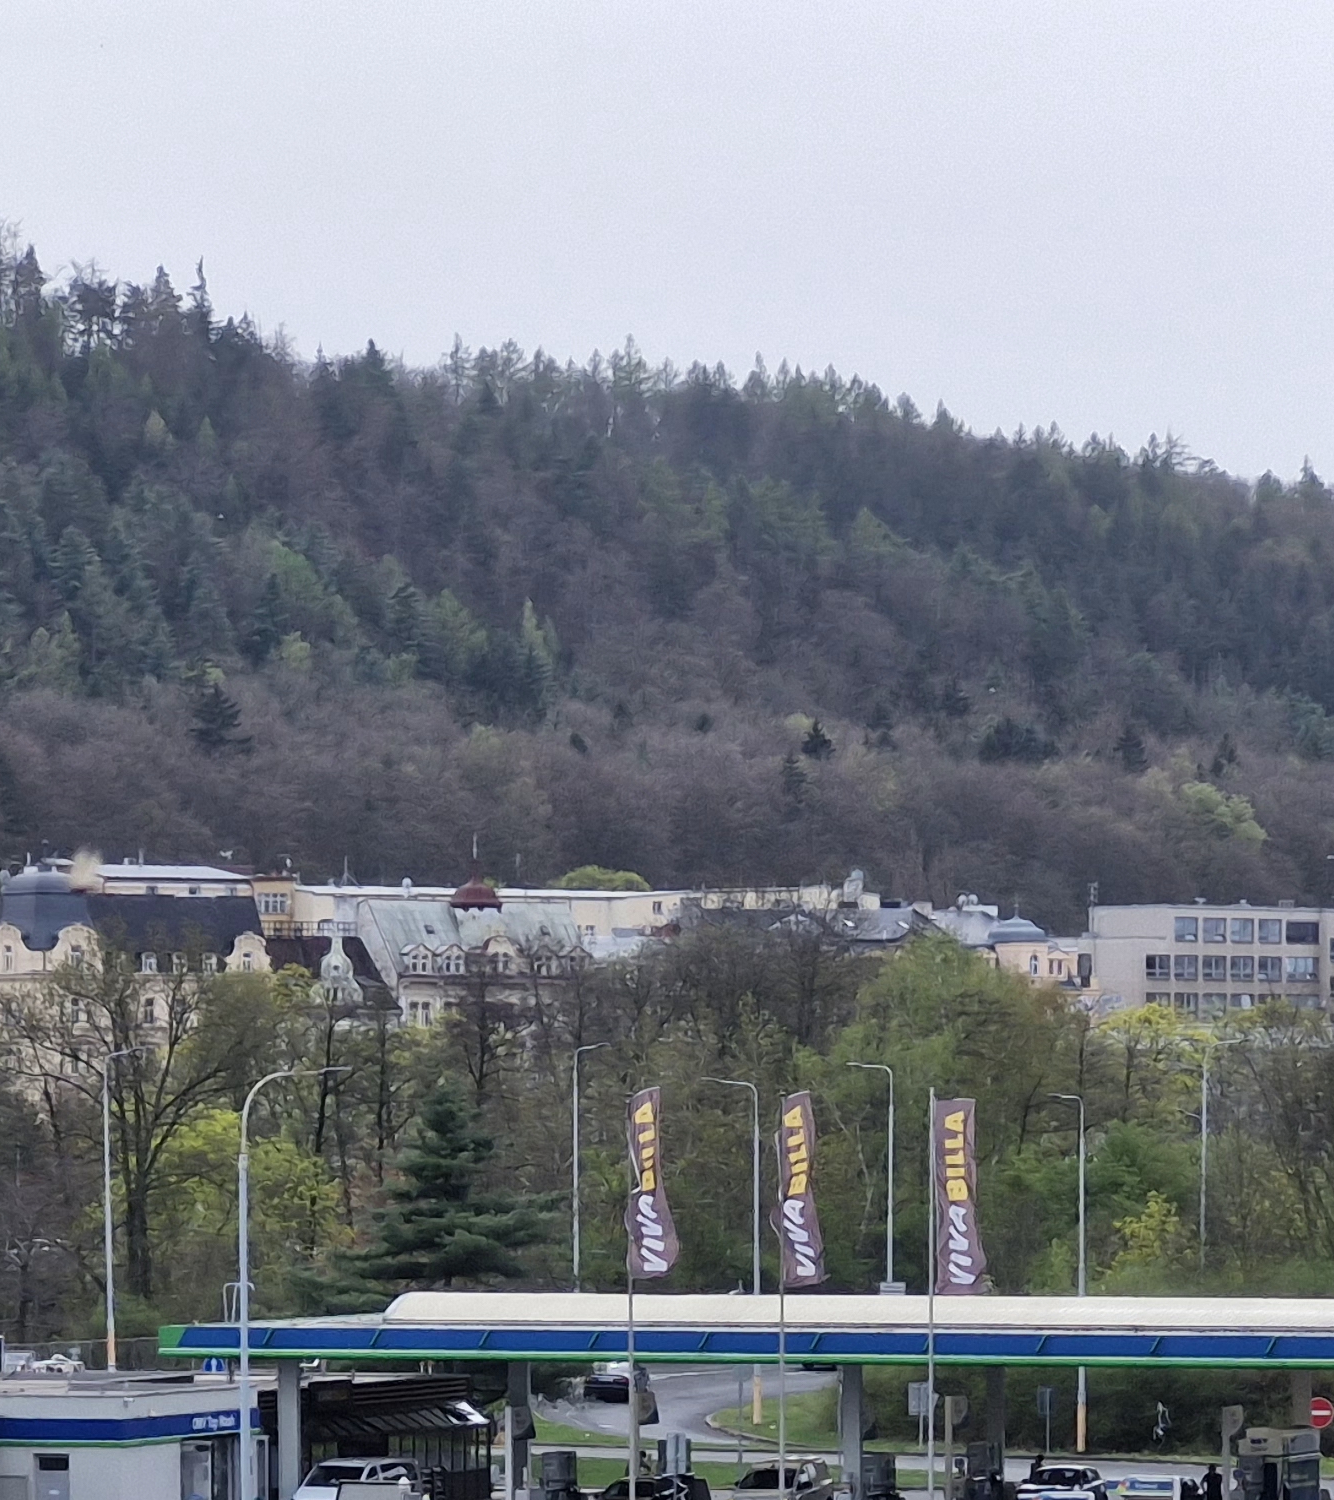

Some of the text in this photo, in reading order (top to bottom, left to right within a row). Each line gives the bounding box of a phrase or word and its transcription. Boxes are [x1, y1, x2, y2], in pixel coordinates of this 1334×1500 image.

[635, 1194, 668, 1272] VIVA
[783, 1105, 816, 1277] VIVA BILLA
[944, 1110, 976, 1285] VIVA BILLA
